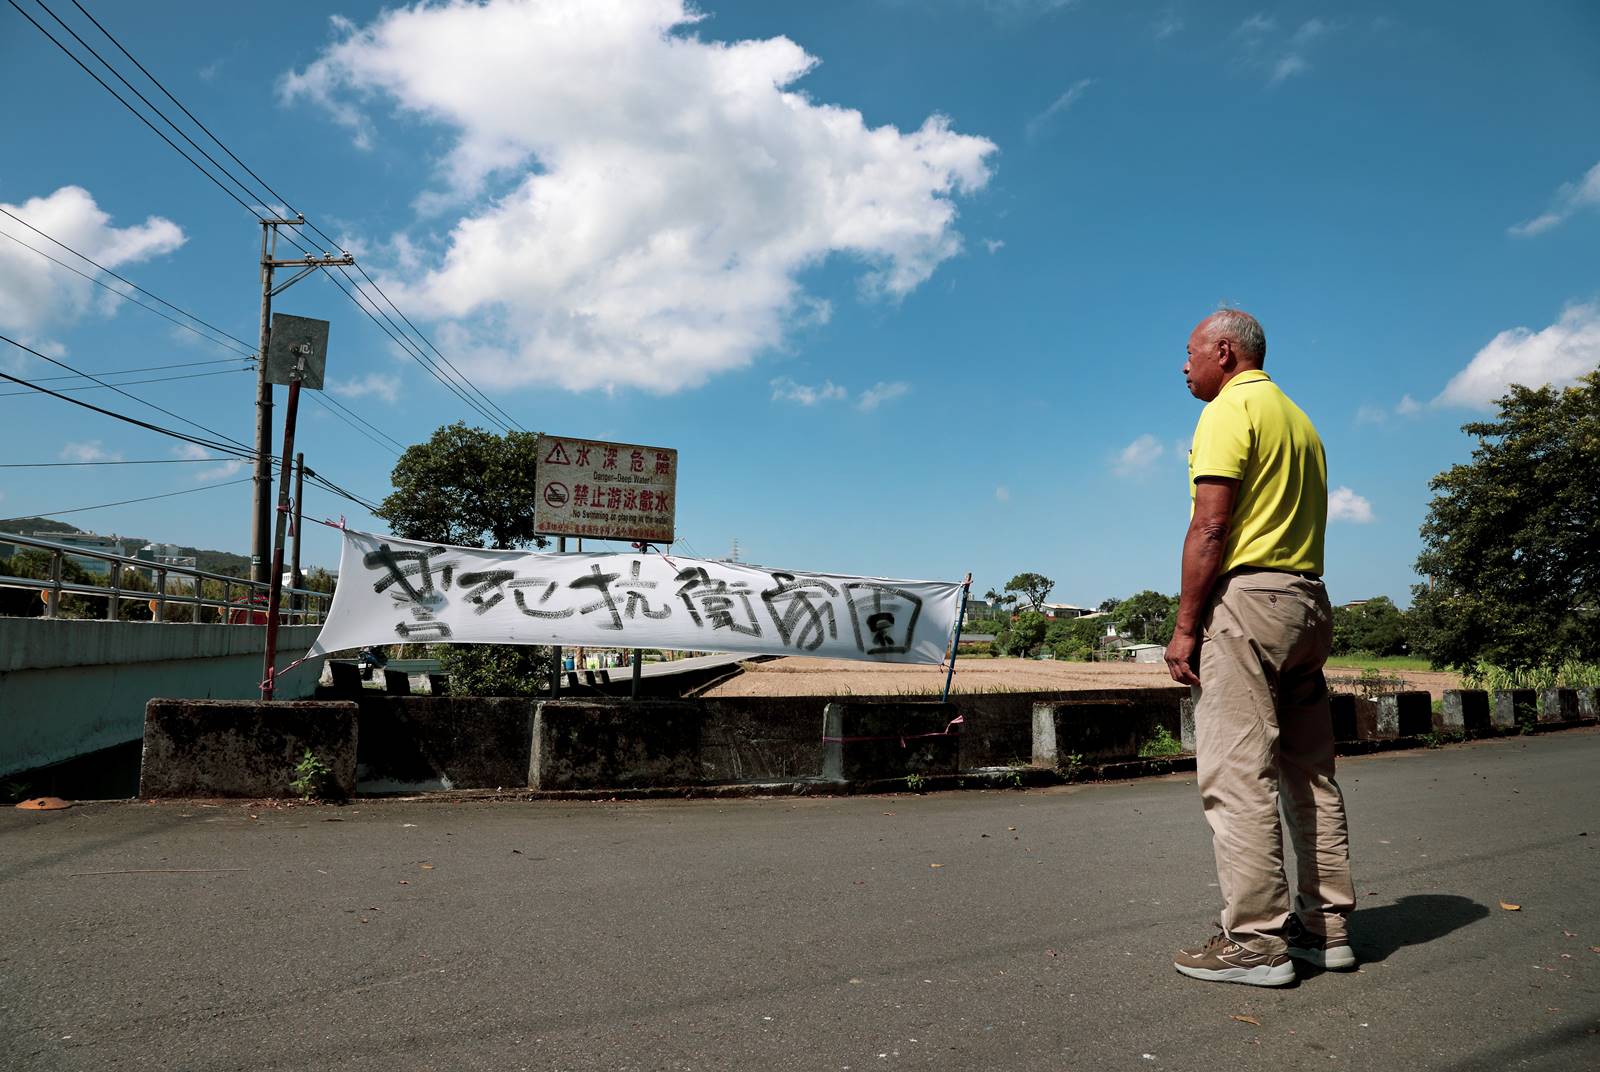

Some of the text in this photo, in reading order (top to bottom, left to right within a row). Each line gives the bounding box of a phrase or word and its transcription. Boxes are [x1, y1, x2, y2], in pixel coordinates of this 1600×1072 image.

[576, 445, 671, 475] 水深危險
[574, 483, 669, 513] 禁止游泳戲水
[572, 509, 580, 518] No
[1223, 944, 1240, 954] FILA
